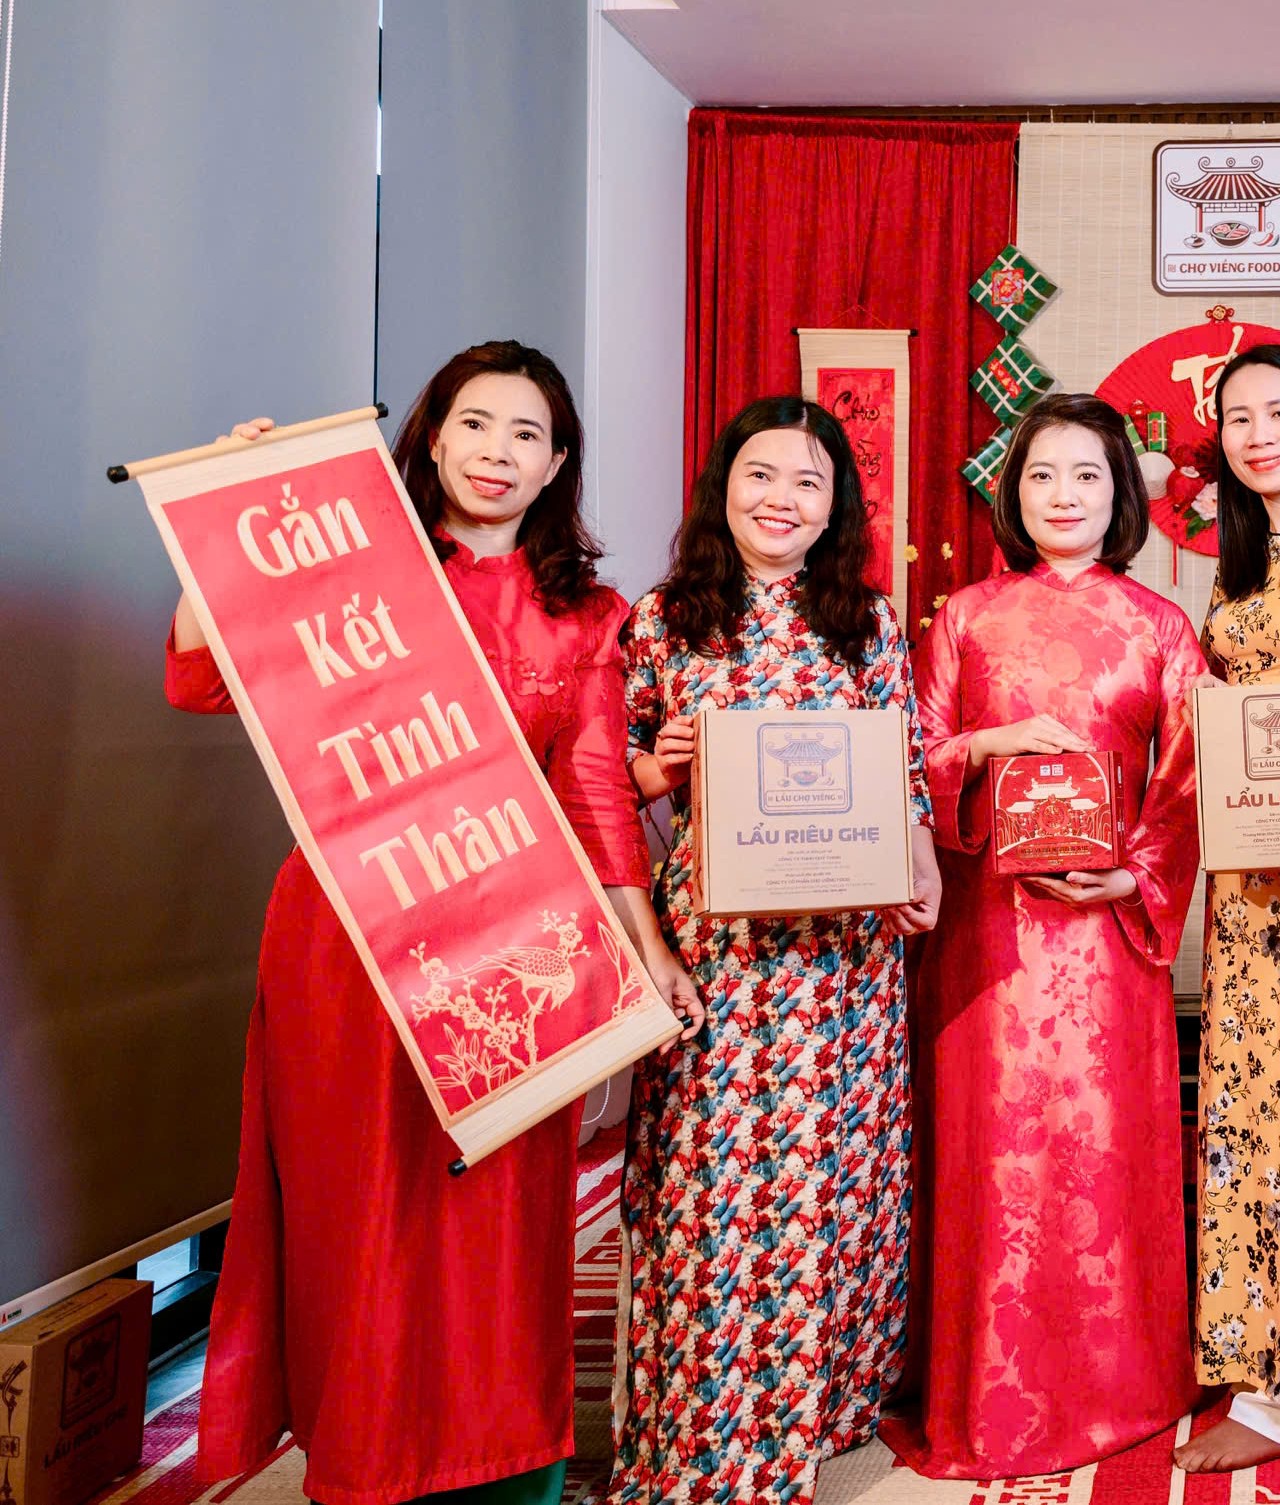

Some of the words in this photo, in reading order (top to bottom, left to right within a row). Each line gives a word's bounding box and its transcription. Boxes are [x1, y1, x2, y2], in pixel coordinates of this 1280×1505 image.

[1179, 262, 1207, 276] CHỢ
[1248, 261, 1280, 273] FOOD
[236, 483, 372, 578] Gắn
[293, 592, 411, 689] Kết
[317, 690, 480, 803] Tình
[736, 822, 780, 846] LẨU
[784, 825, 833, 845] RIÊU
[838, 826, 880, 844] GHẸ
[1225, 787, 1264, 809] LẨU
[359, 797, 539, 911] Thân
